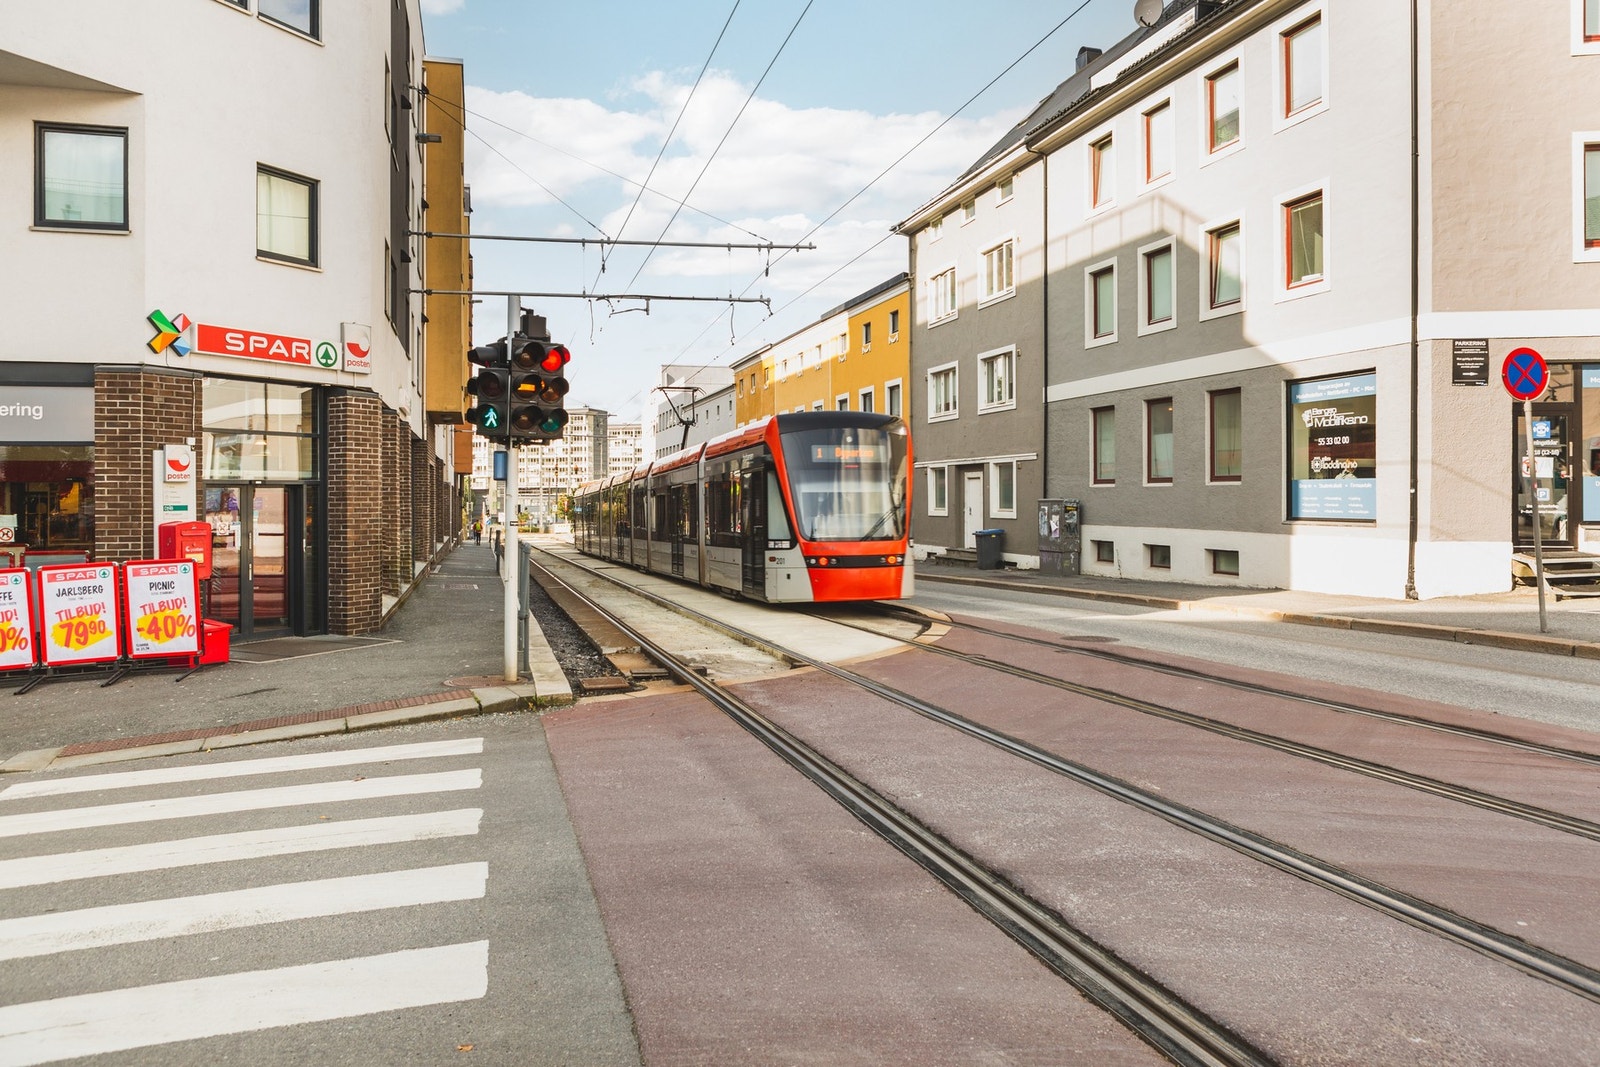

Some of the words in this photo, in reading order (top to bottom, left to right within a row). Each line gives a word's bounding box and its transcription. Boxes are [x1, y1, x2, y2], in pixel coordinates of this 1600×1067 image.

[225, 332, 310, 360] SPAR
[346, 359, 370, 368] posten
[0, 403, 43, 420] ering
[1317, 438, 1325, 446] 55
[1325, 437, 1333, 445] 33
[1334, 436, 1341, 445] 02
[1341, 435, 1350, 444] 00
[776, 557, 785, 565] 201
[56, 570, 96, 581] SPAR
[140, 566, 177, 576] SPAR
[56, 585, 104, 597] JARLSBERG
[149, 580, 175, 591] PICNIC
[55, 602, 106, 622] TILBUD!
[140, 597, 187, 616] TILBUD!
[136, 614, 196, 640] -40%
